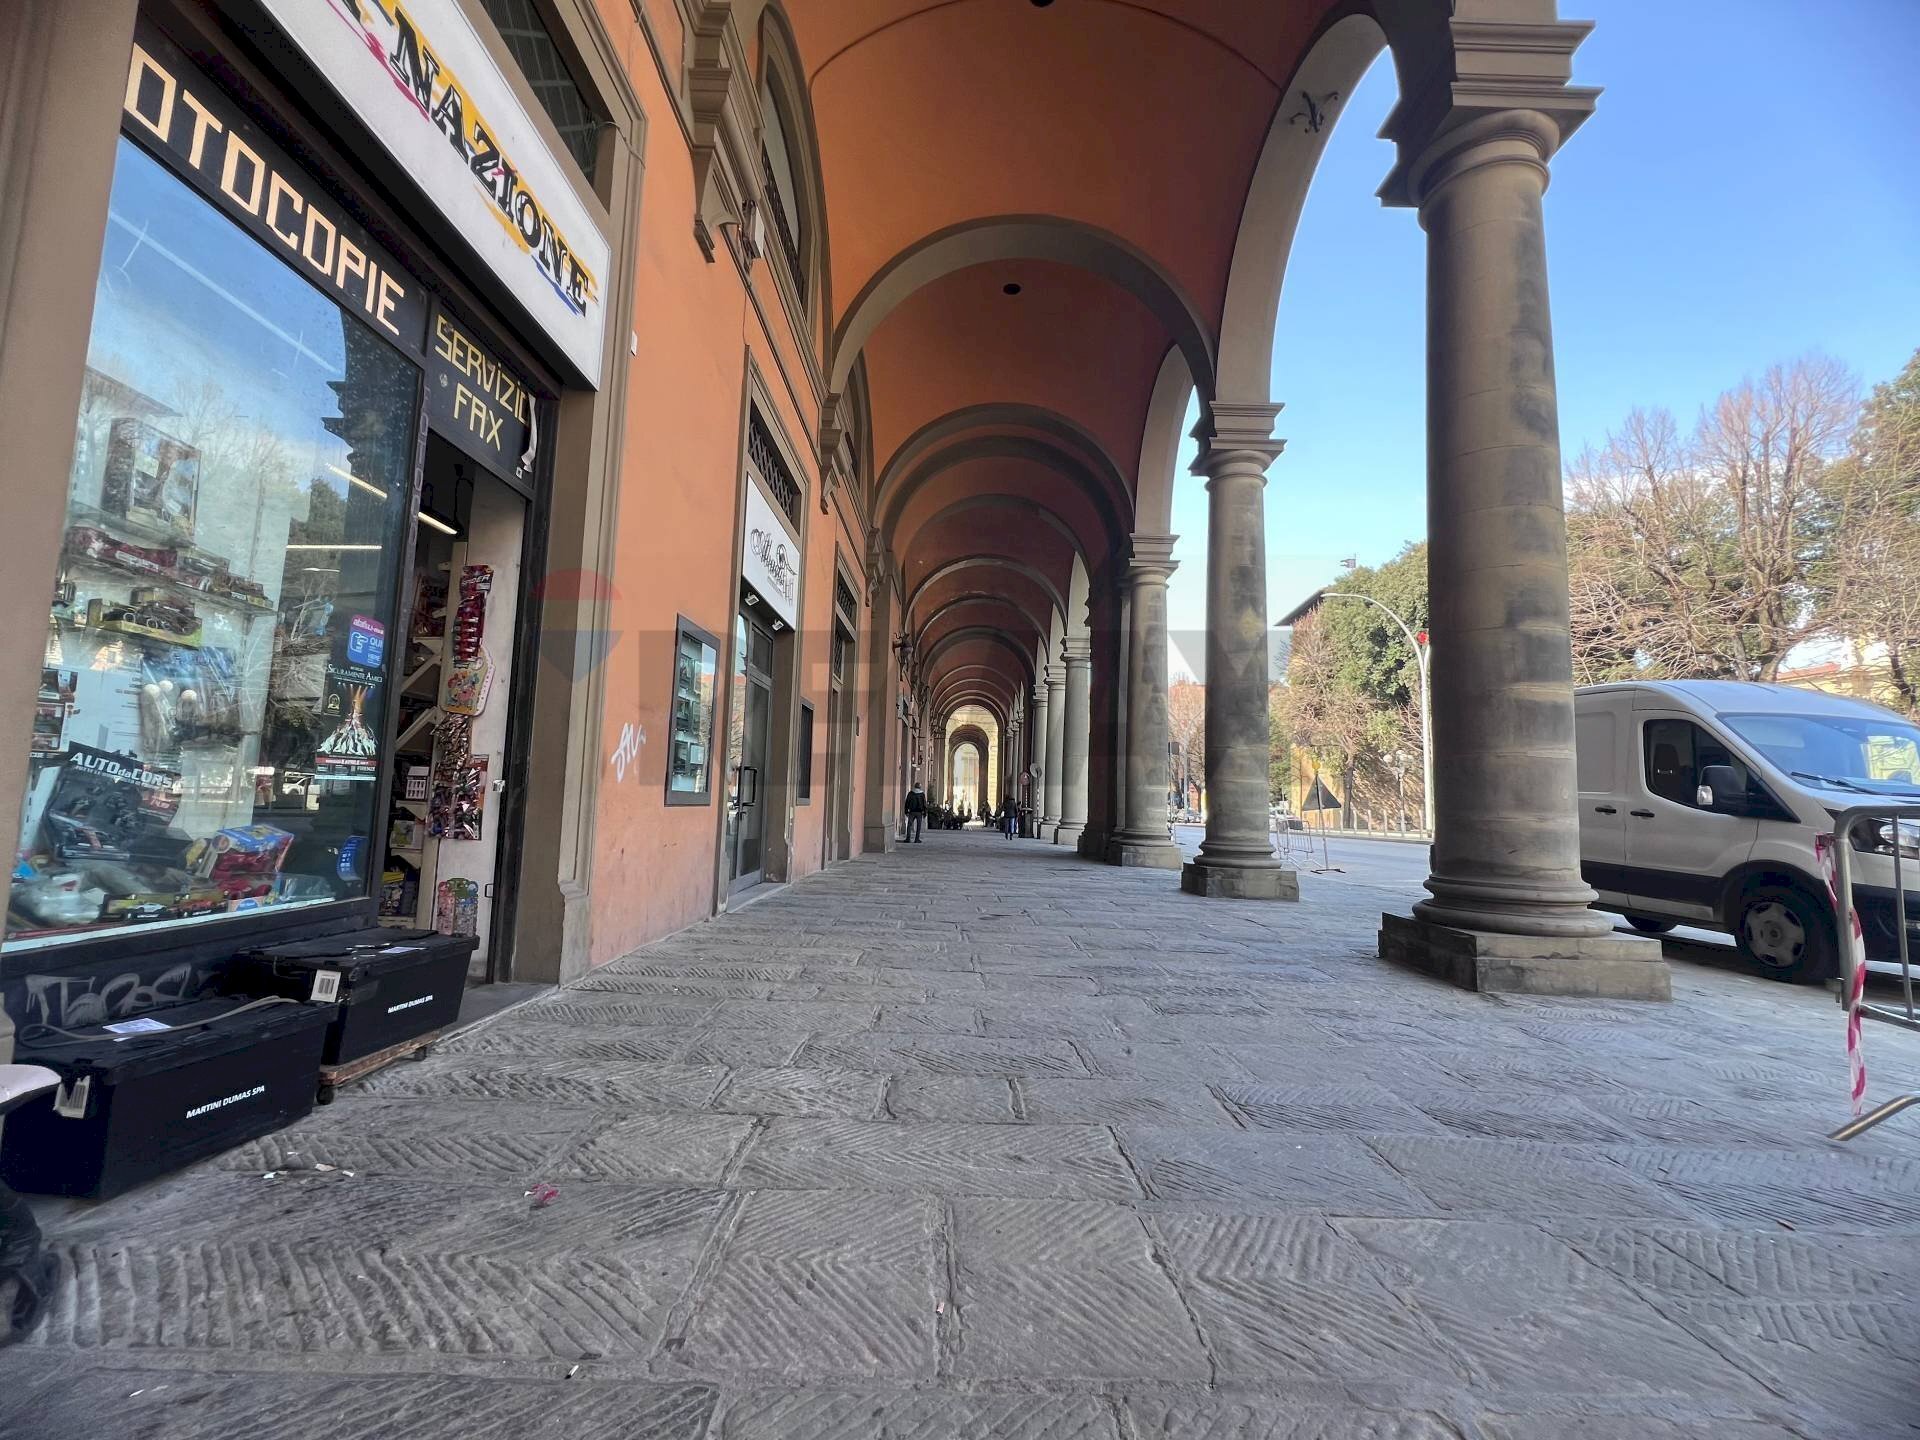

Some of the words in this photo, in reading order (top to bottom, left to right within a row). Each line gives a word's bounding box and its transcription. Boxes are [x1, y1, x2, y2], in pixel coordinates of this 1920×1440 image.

[123, 42, 405, 336] OTOCOPIE
[390, 6, 589, 318] NAZIONE
[453, 382, 504, 451] FAX
[369, 637, 383, 648] QUI
[185, 1099, 222, 1119] MARTINI
[222, 1089, 251, 1107] DUMAS
[251, 1085, 265, 1096] SPA
